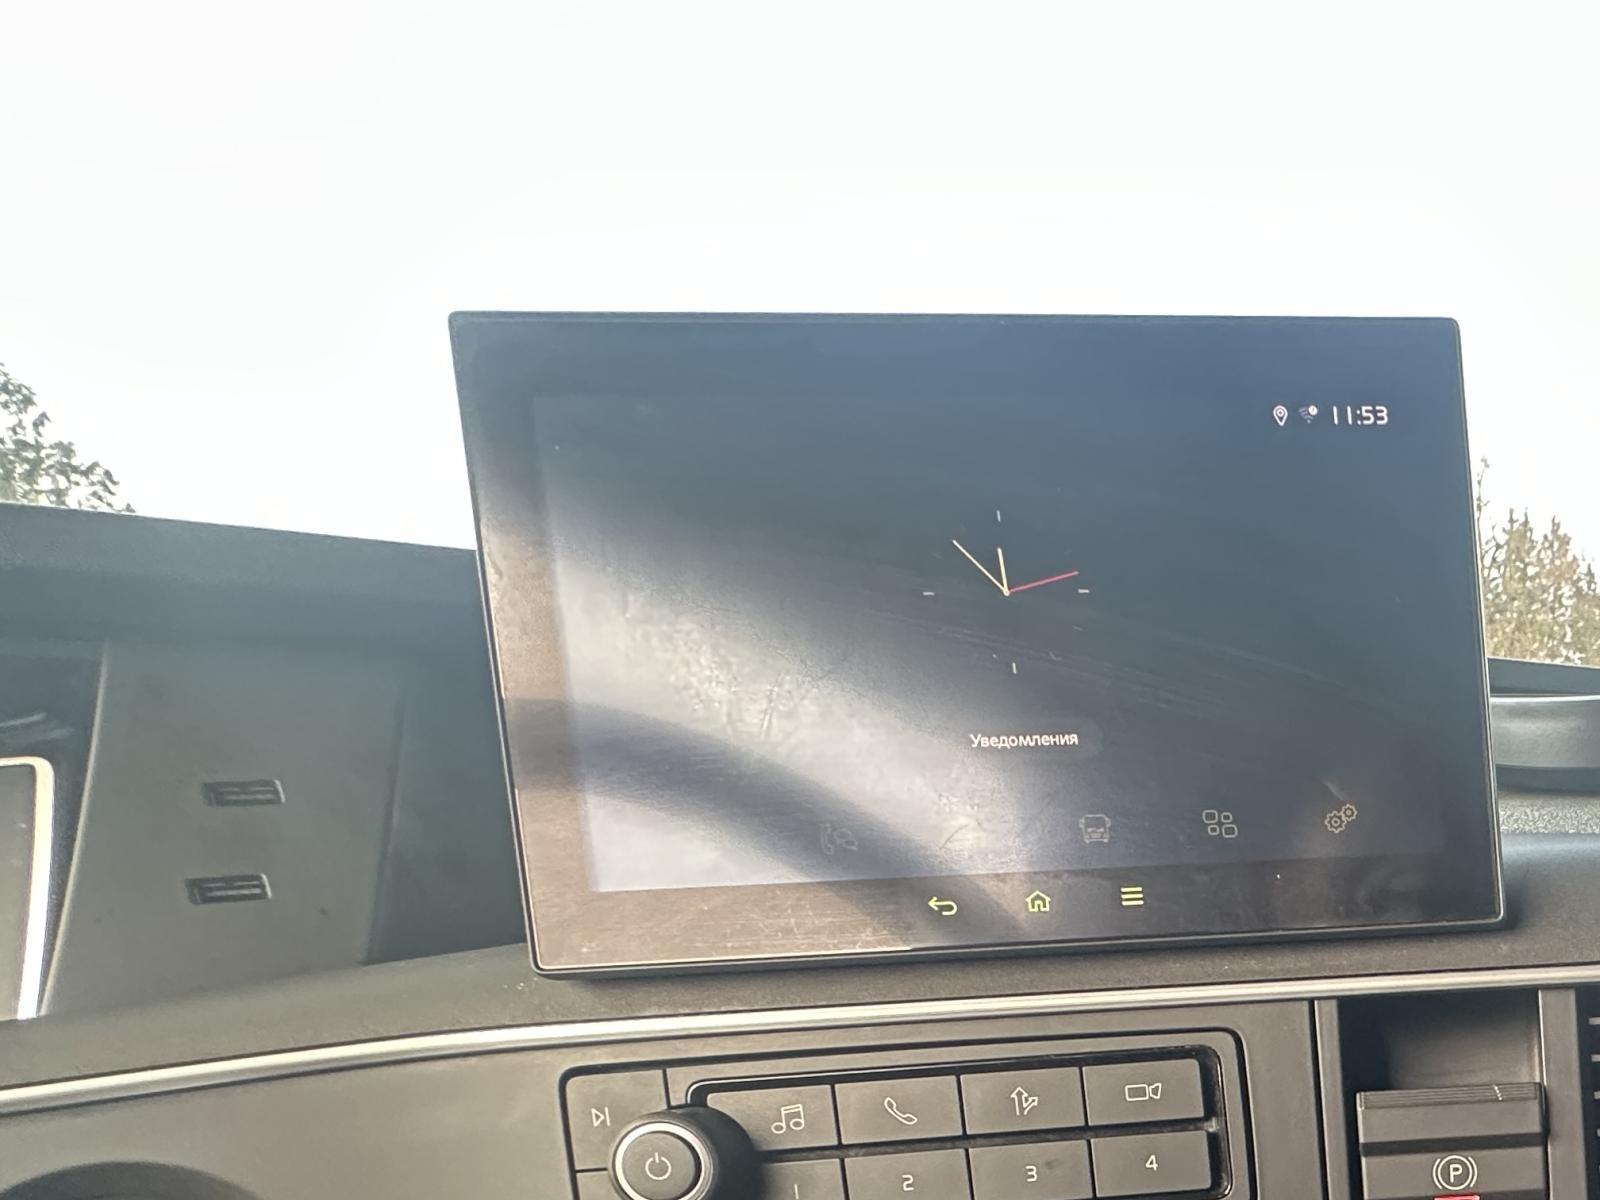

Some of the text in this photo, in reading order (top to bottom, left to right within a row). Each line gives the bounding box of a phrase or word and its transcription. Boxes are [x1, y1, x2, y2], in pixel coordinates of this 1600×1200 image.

[1332, 405, 1389, 425] 11:53
[969, 733, 1079, 750] Уведомления
[1145, 1154, 1158, 1171] 4
[1026, 1165, 1037, 1182] 3
[1449, 1163, 1463, 1183] P
[902, 1174, 914, 1191] 2
